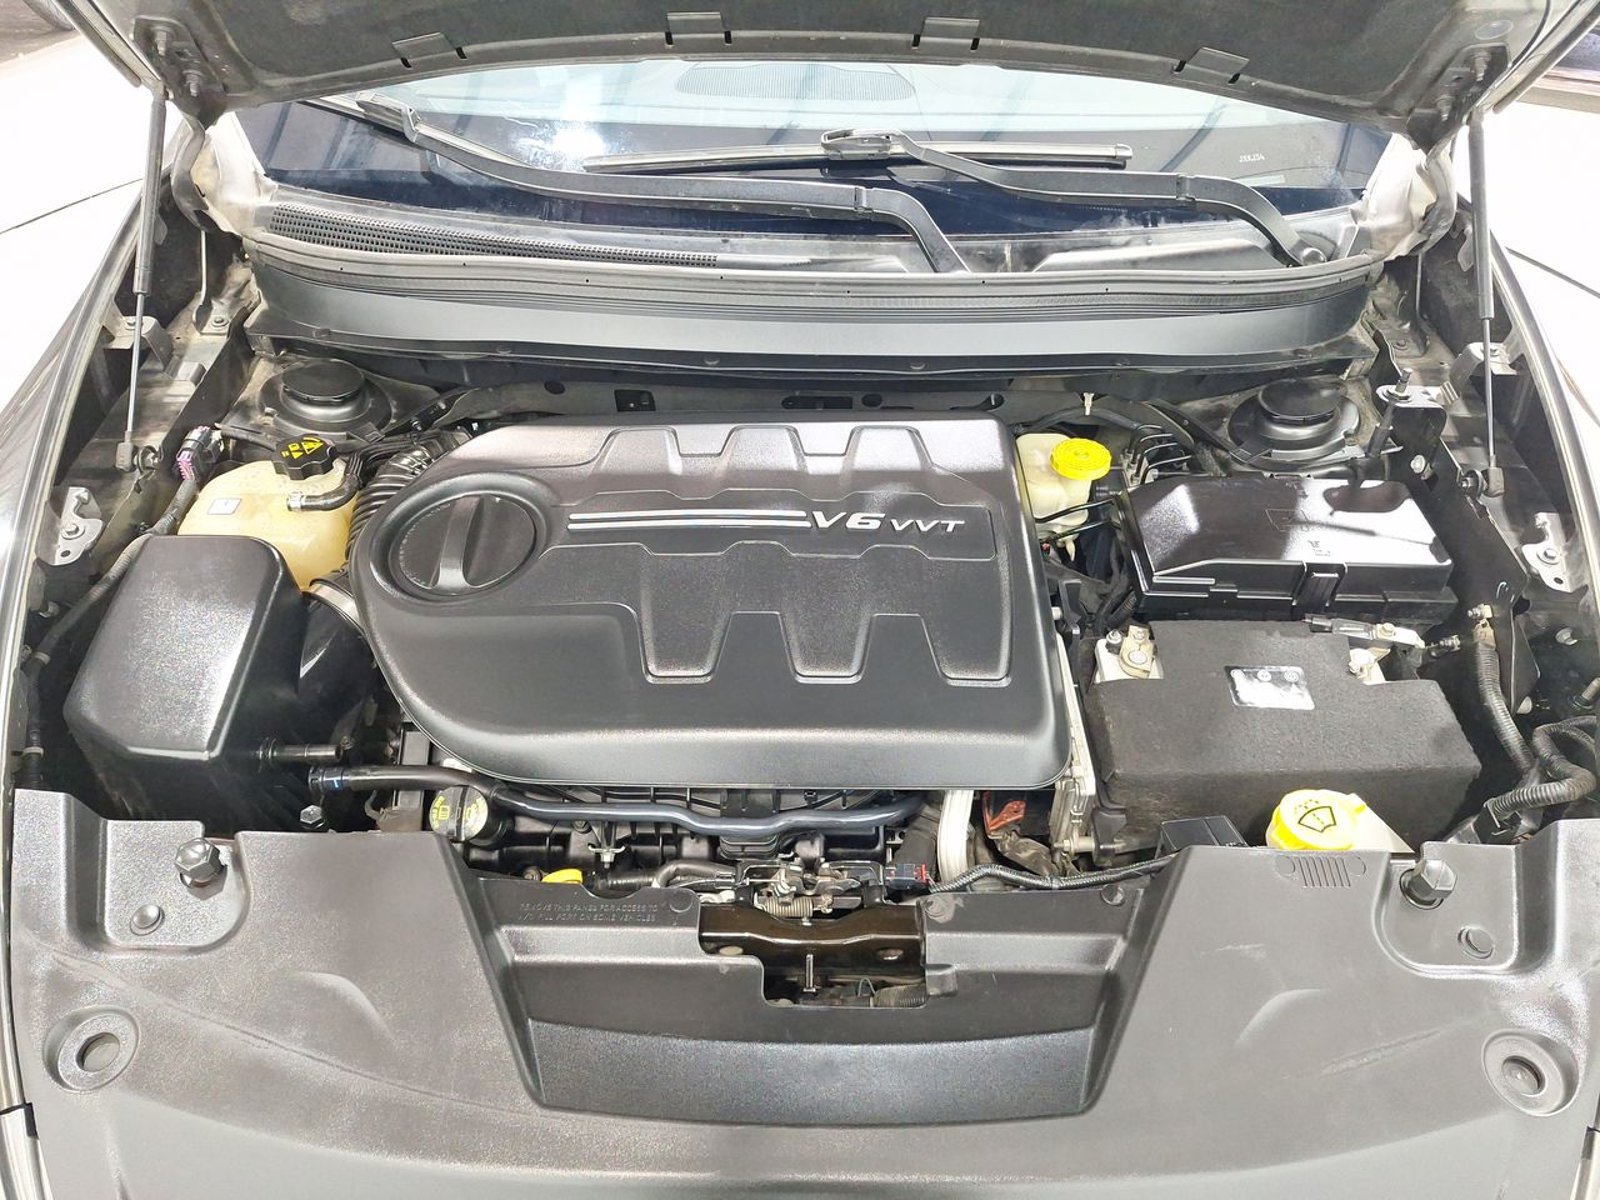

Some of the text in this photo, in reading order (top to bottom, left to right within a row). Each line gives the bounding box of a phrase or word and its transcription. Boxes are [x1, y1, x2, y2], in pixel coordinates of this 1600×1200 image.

[812, 510, 966, 533] V6 VVT
[573, 903, 598, 912] PANEL
[600, 904, 615, 912] FOR
[616, 904, 647, 912] ACCESS
[648, 904, 659, 912] TO
[538, 913, 554, 921] FLL
[579, 913, 592, 921] ON
[619, 913, 657, 922] VEHCLES
